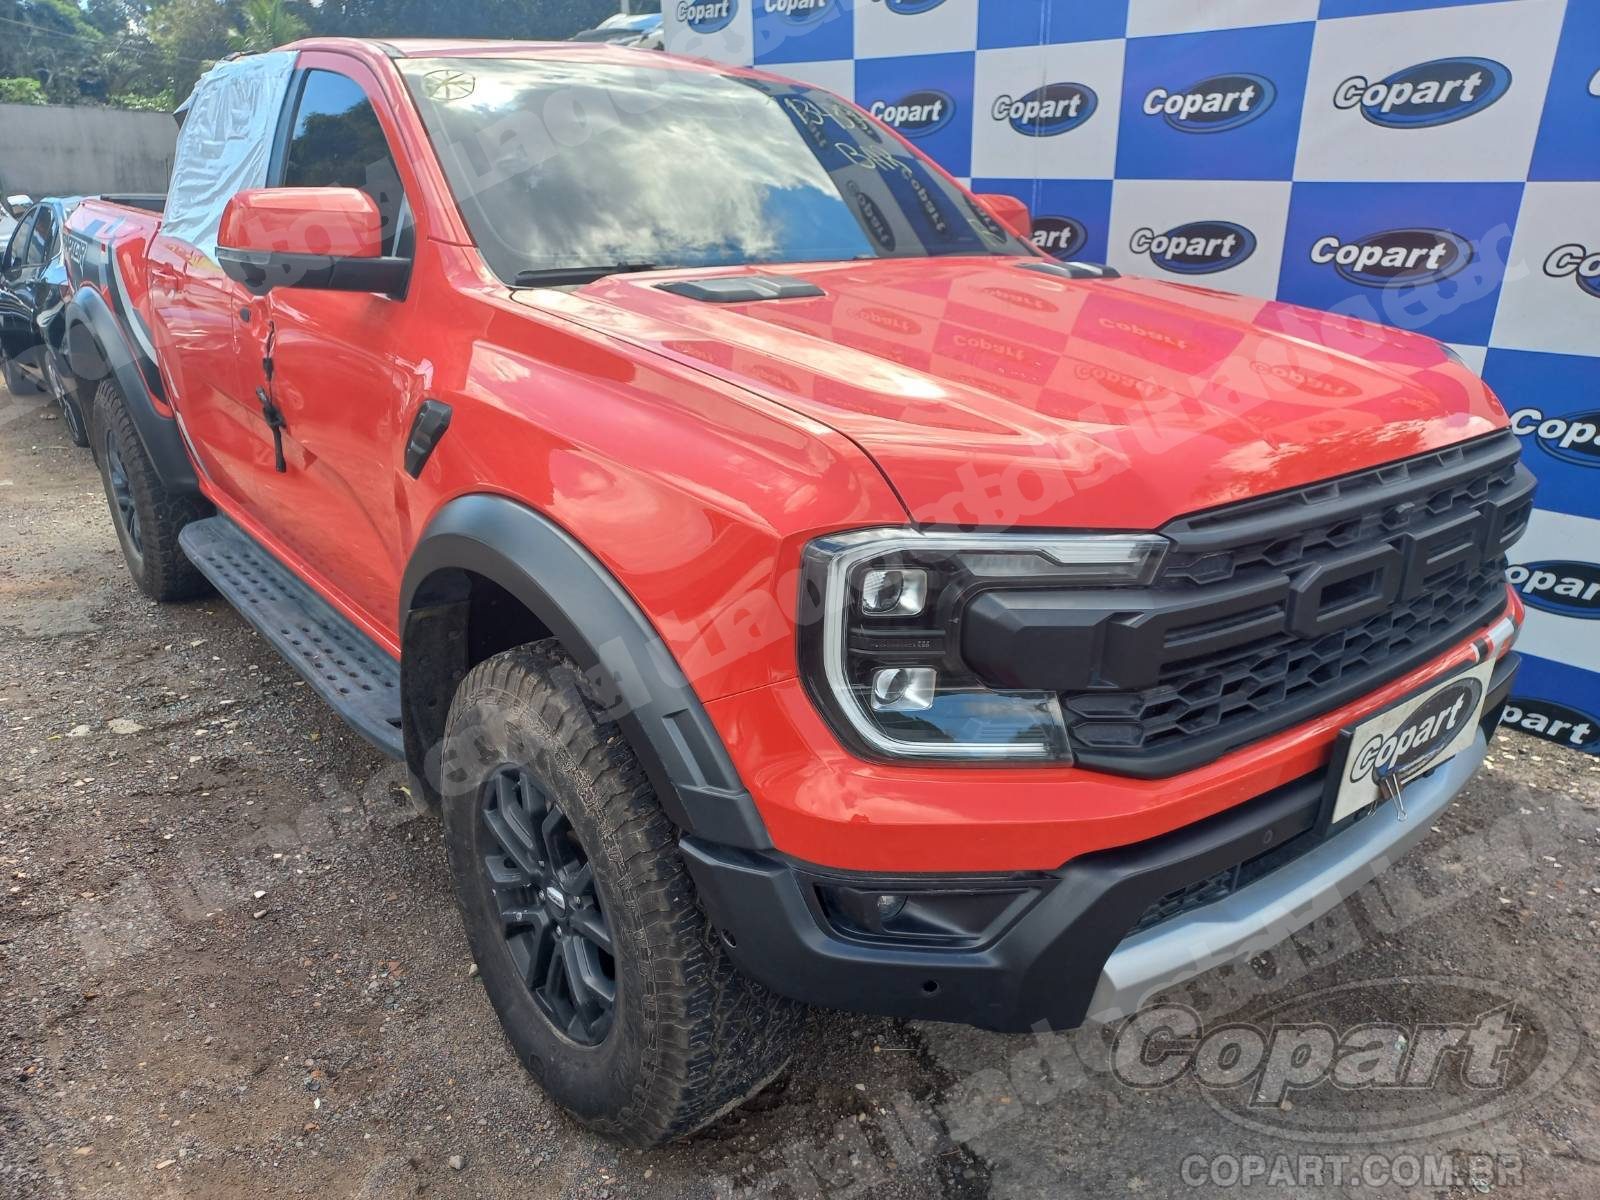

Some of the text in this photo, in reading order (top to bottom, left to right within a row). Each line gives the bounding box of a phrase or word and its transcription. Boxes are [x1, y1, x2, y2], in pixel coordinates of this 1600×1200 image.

[676, 0, 729, 25] Copart
[1143, 85, 1256, 119] Copart
[1335, 71, 1483, 112] Copart
[870, 99, 943, 127] Copart
[993, 93, 1081, 127] Copart
[1032, 226, 1072, 249] art
[1130, 227, 1236, 259] Copart
[1311, 236, 1447, 271] Copart
[1509, 407, 1600, 448] Cop
[1095, 487, 1534, 690] FORD
[1504, 564, 1600, 601] opar
[1350, 692, 1466, 783] Copart
[1500, 704, 1592, 745] part
